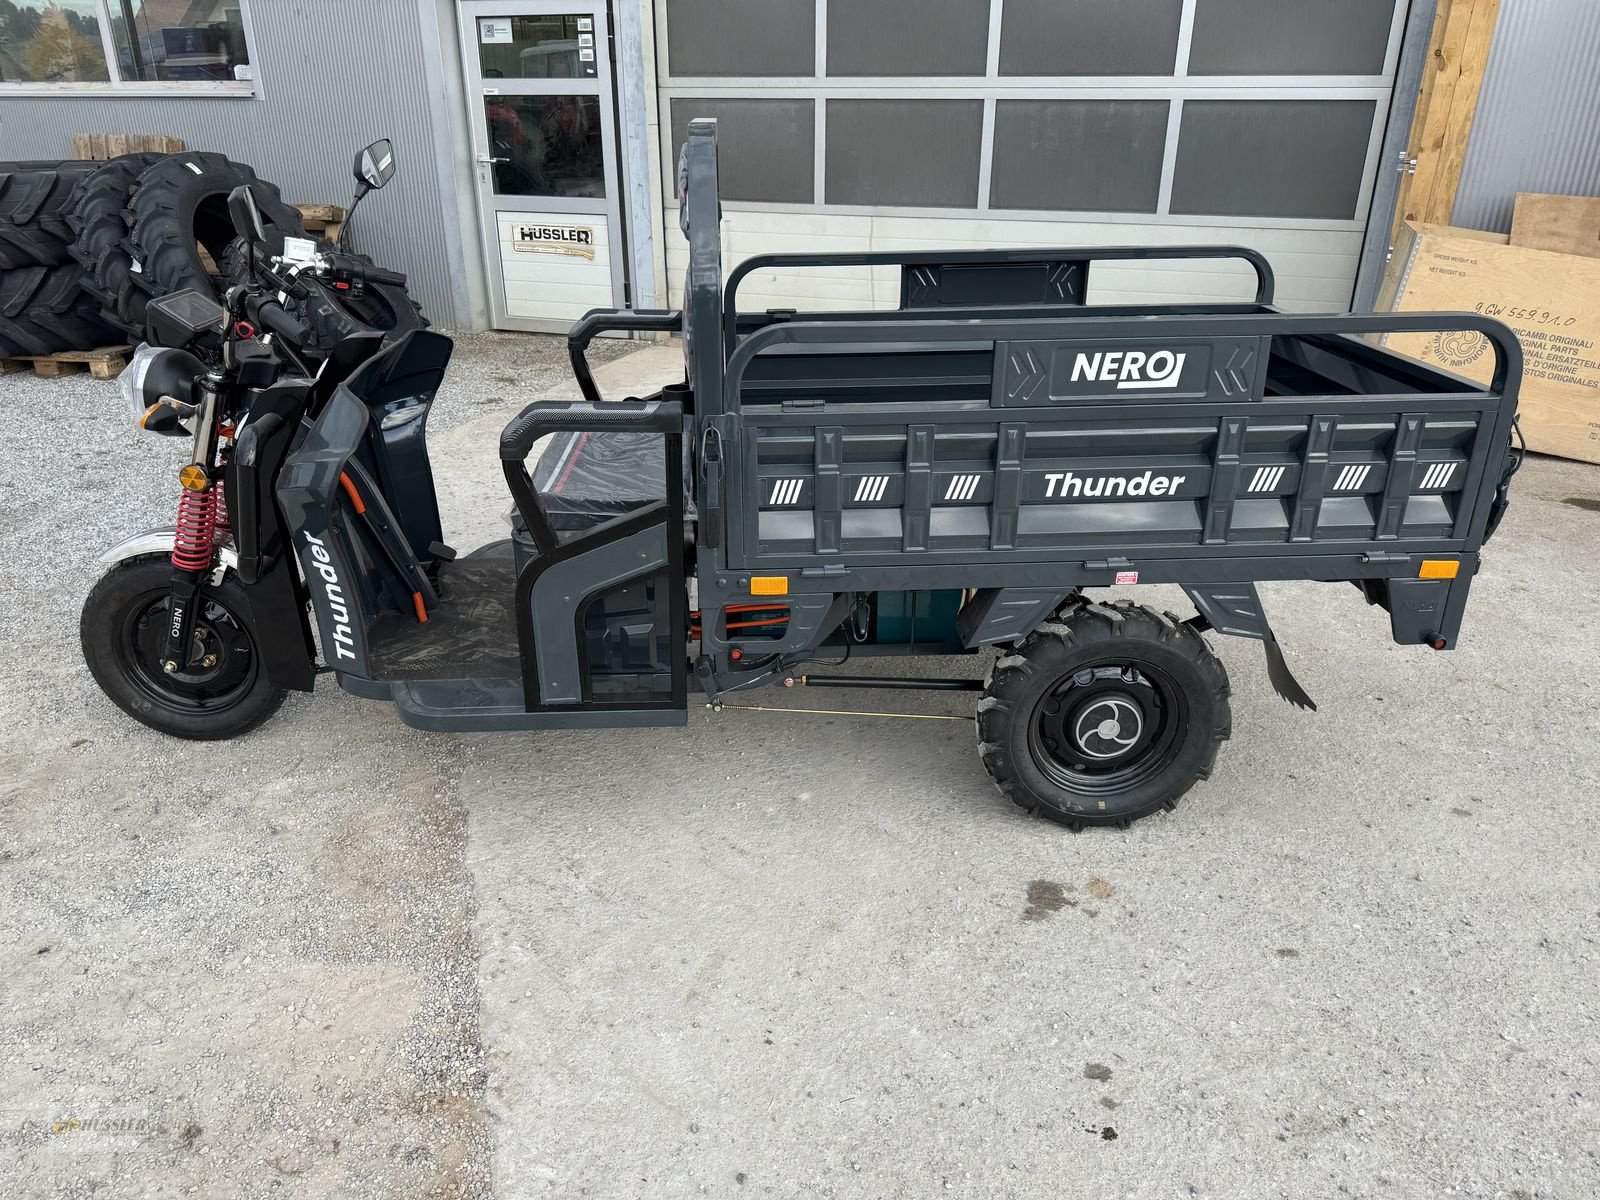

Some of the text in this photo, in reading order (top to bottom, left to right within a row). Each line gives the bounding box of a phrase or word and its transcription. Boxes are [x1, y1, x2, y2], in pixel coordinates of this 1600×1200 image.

[1451, 256, 1470, 264] WEIGHT
[1439, 268, 1458, 276] WEIGHT
[1549, 334, 1594, 349] ORIGINALI
[1550, 344, 1579, 356] PARTS
[1070, 350, 1180, 385] NERO
[1533, 360, 1578, 375] D'ORIGINE
[1547, 372, 1599, 388] ORIGINALES
[1044, 471, 1186, 497] Thunder
[303, 530, 356, 660] Thunder
[171, 607, 183, 638] NERO
